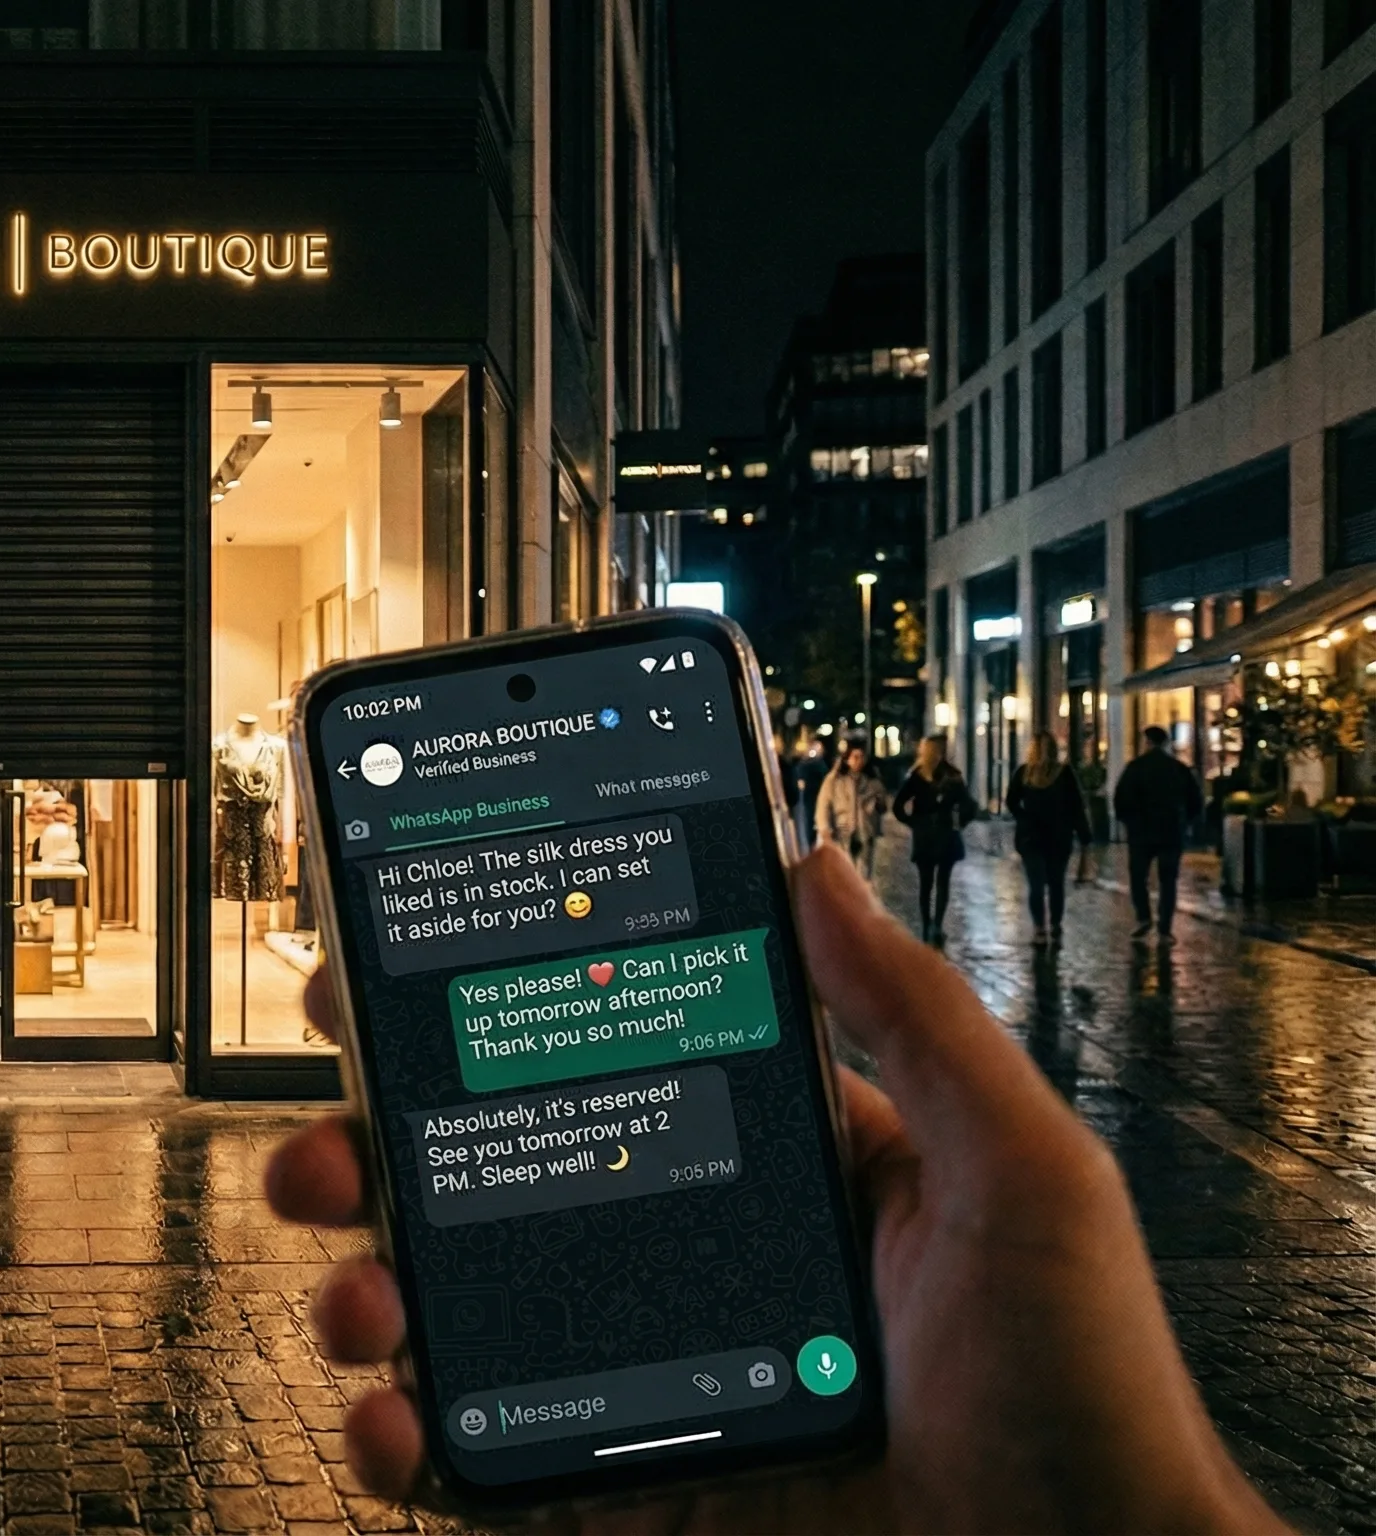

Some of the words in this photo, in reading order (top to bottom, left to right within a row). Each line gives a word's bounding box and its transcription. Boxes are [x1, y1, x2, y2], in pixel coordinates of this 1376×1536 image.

[47, 233, 329, 283] BOUTIQUE
[344, 701, 390, 720] 10:02
[394, 696, 421, 713] PM
[413, 731, 492, 758] AURORA
[497, 714, 595, 744] BOUTIQUE
[415, 758, 469, 778] Verified
[473, 751, 536, 770] Business
[390, 808, 472, 830] WhatsApp
[477, 796, 549, 817] Business
[378, 866, 401, 887] Hi
[407, 855, 474, 882] Chloe!
[479, 850, 520, 870] The
[527, 841, 564, 864] silk
[570, 836, 627, 857] dress
[633, 829, 672, 852] you
[383, 888, 433, 914] liked
[439, 887, 458, 906] is
[464, 883, 483, 902] in
[489, 872, 555, 899] stock.
[560, 869, 566, 887] I
[573, 866, 611, 884] can
[618, 857, 650, 878] set
[388, 924, 403, 942] it
[409, 913, 465, 939] aside
[471, 909, 501, 929] for
[507, 899, 555, 929] you?
[664, 908, 690, 924] PM
[459, 985, 499, 1004] Yes
[505, 969, 581, 1003] please!
[623, 960, 664, 978] Can
[670, 953, 676, 972] I
[683, 946, 728, 975] pick
[733, 943, 748, 962] it
[466, 1016, 492, 1036] up
[498, 998, 600, 1027] tomorrow
[609, 975, 722, 1010] afternoon?
[469, 1032, 537, 1059] Thank
[542, 1030, 581, 1053] you
[587, 1025, 612, 1041] so
[619, 1009, 684, 1036] much!
[679, 1033, 714, 1052] 9:06
[718, 1030, 744, 1046] PM
[424, 1105, 540, 1139] Absolutely,
[545, 1098, 575, 1119] it's
[582, 1081, 682, 1113] reserved!
[428, 1147, 468, 1166] See
[474, 1140, 513, 1164] you
[518, 1122, 622, 1152] tomorrow
[630, 1115, 650, 1134] at
[655, 1111, 670, 1130] 2
[433, 1171, 476, 1194] PM.
[482, 1164, 541, 1186] Sleep
[547, 1151, 595, 1175] well!
[709, 1159, 734, 1176] PM
[502, 1396, 606, 1427] Message
